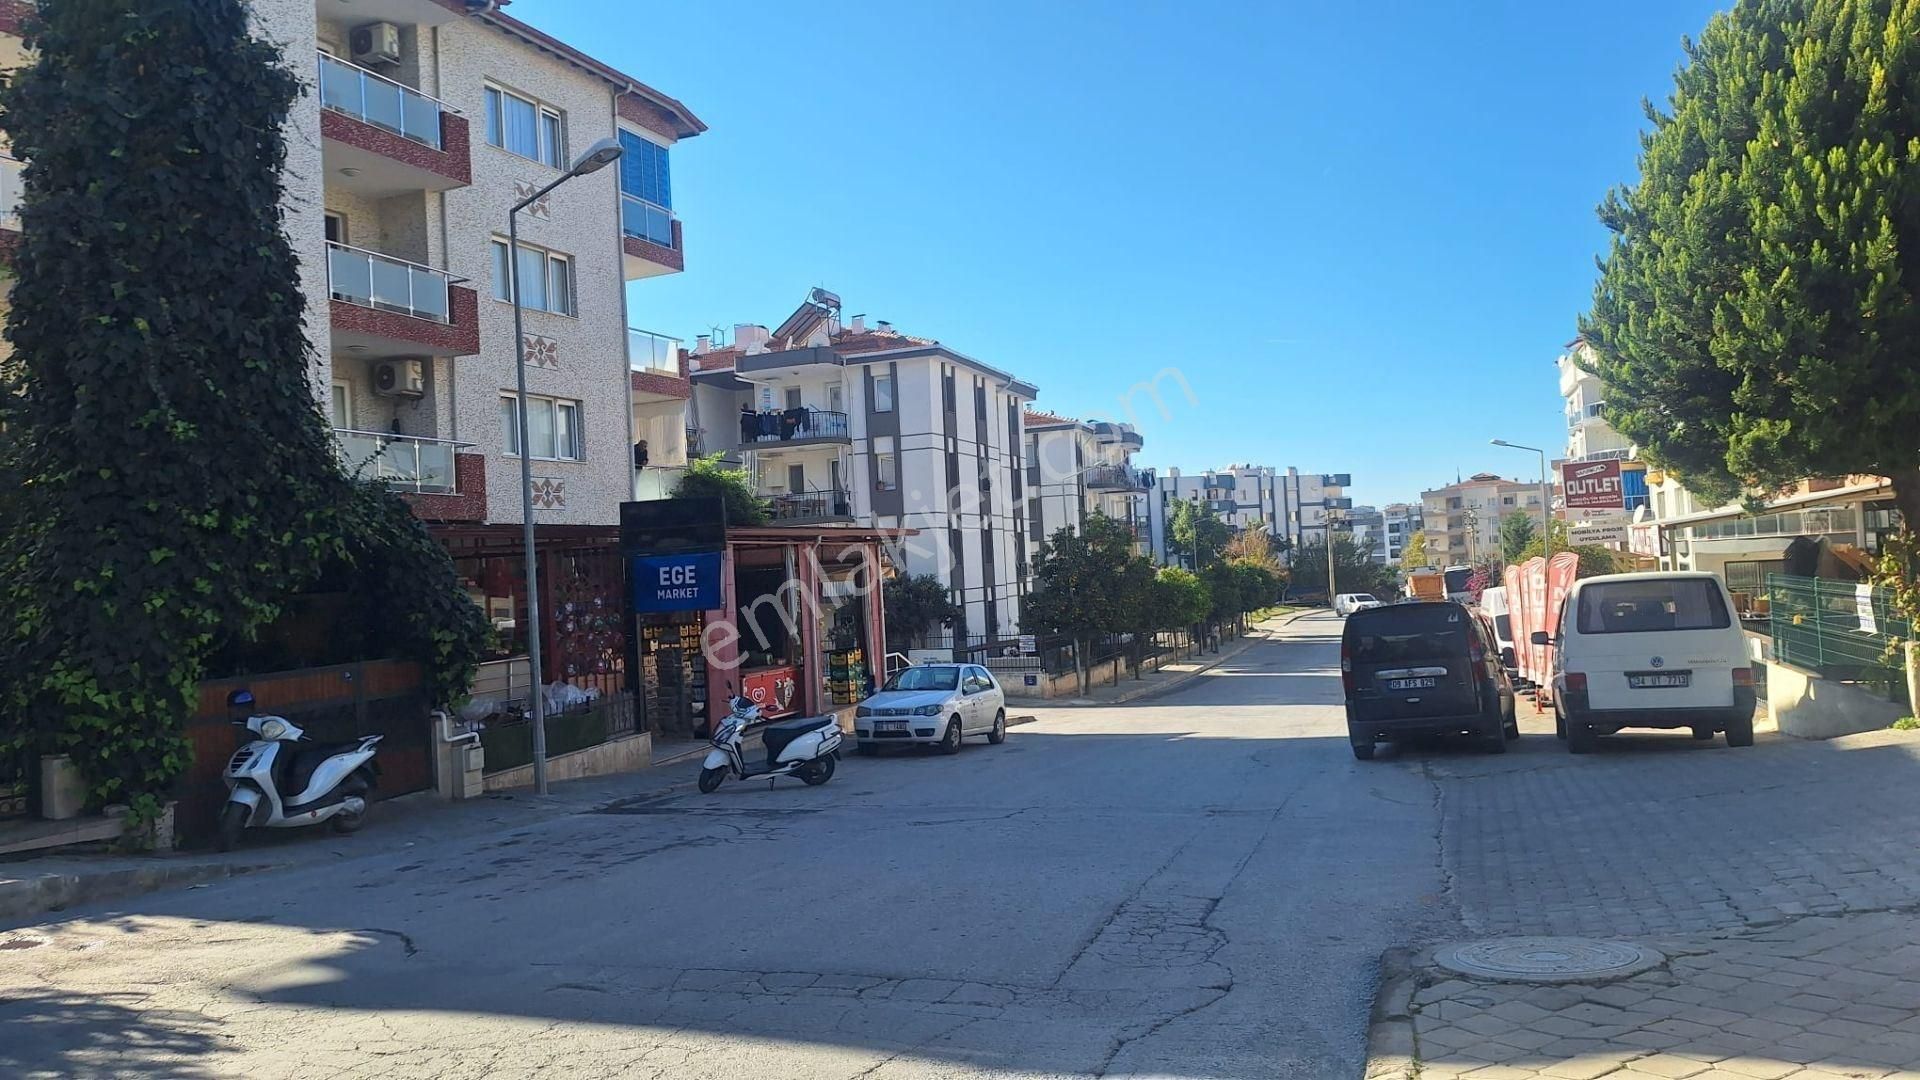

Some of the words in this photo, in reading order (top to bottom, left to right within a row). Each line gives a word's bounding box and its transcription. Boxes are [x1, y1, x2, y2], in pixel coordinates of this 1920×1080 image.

[1566, 476, 1620, 495] OUTLET
[659, 565, 696, 586] EGE
[657, 587, 699, 600] MARKET
